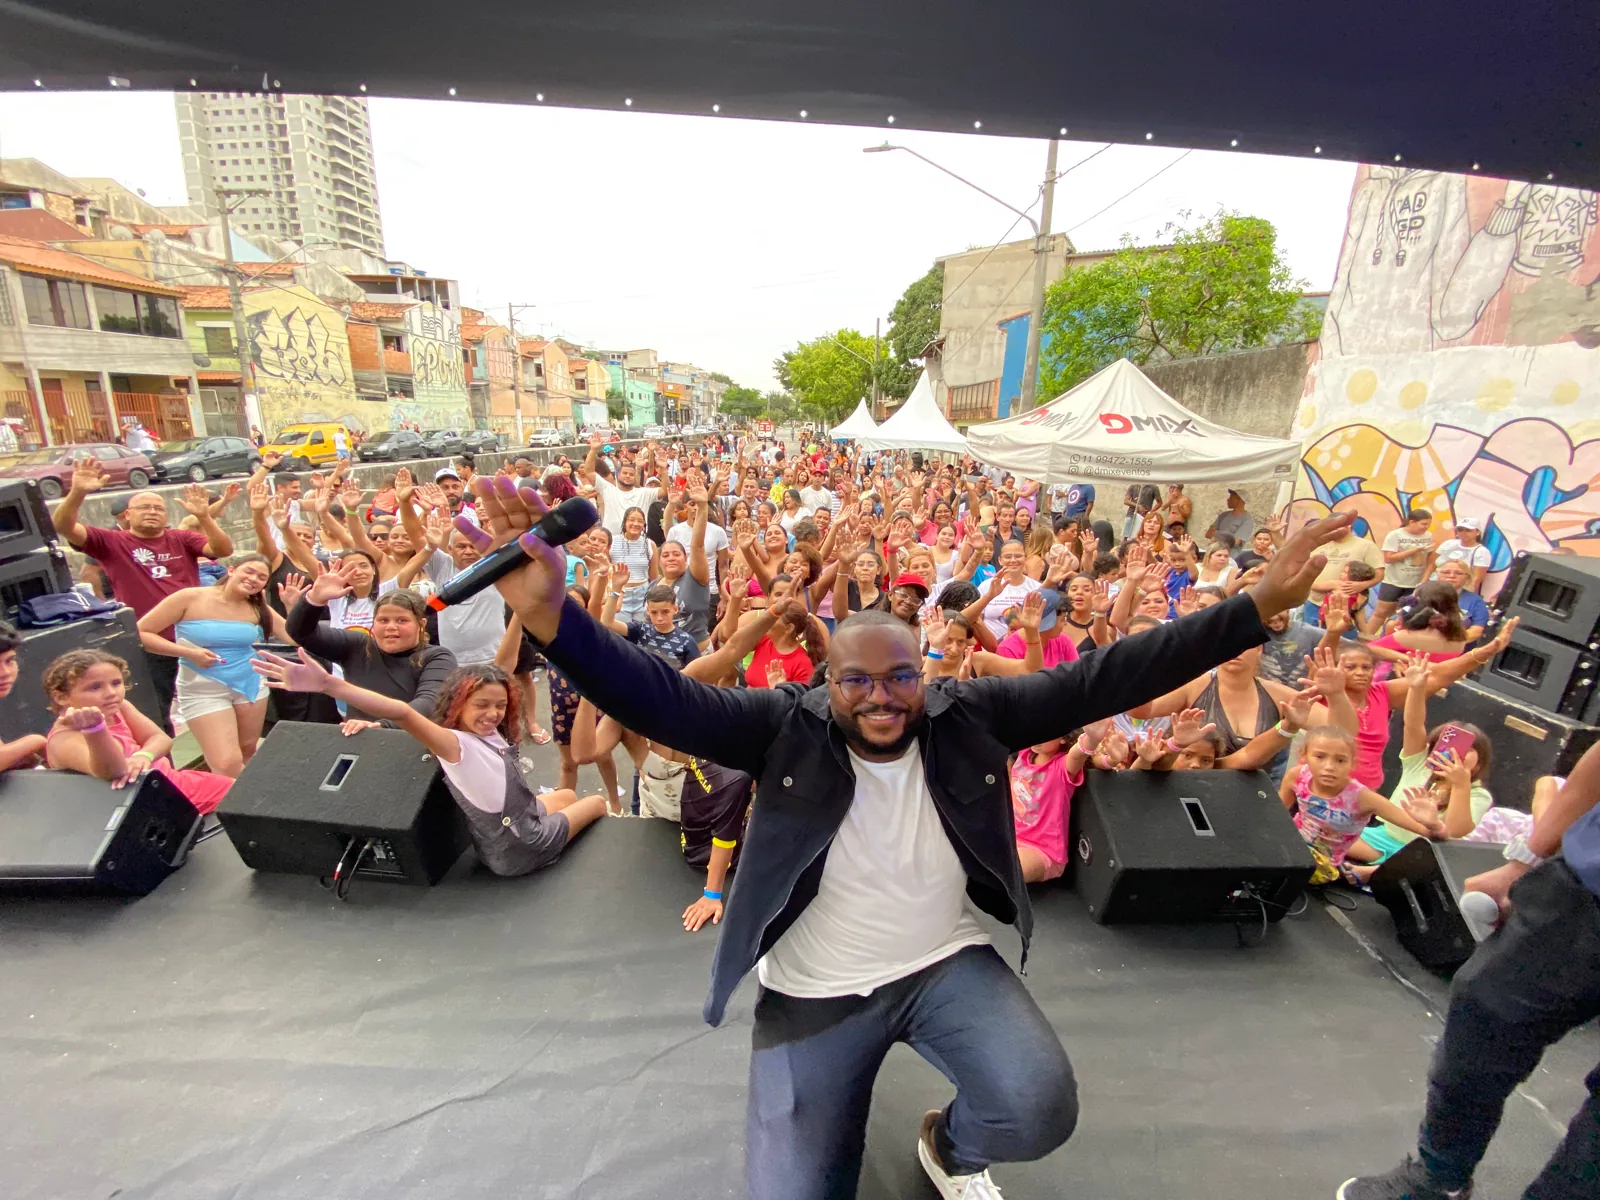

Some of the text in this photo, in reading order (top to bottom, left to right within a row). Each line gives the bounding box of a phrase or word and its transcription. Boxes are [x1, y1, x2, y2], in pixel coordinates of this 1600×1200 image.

[1098, 412, 1208, 438] DMIX
[1095, 455, 1153, 466] 99472-1555
[1083, 465, 1151, 476] @dmixeventos
